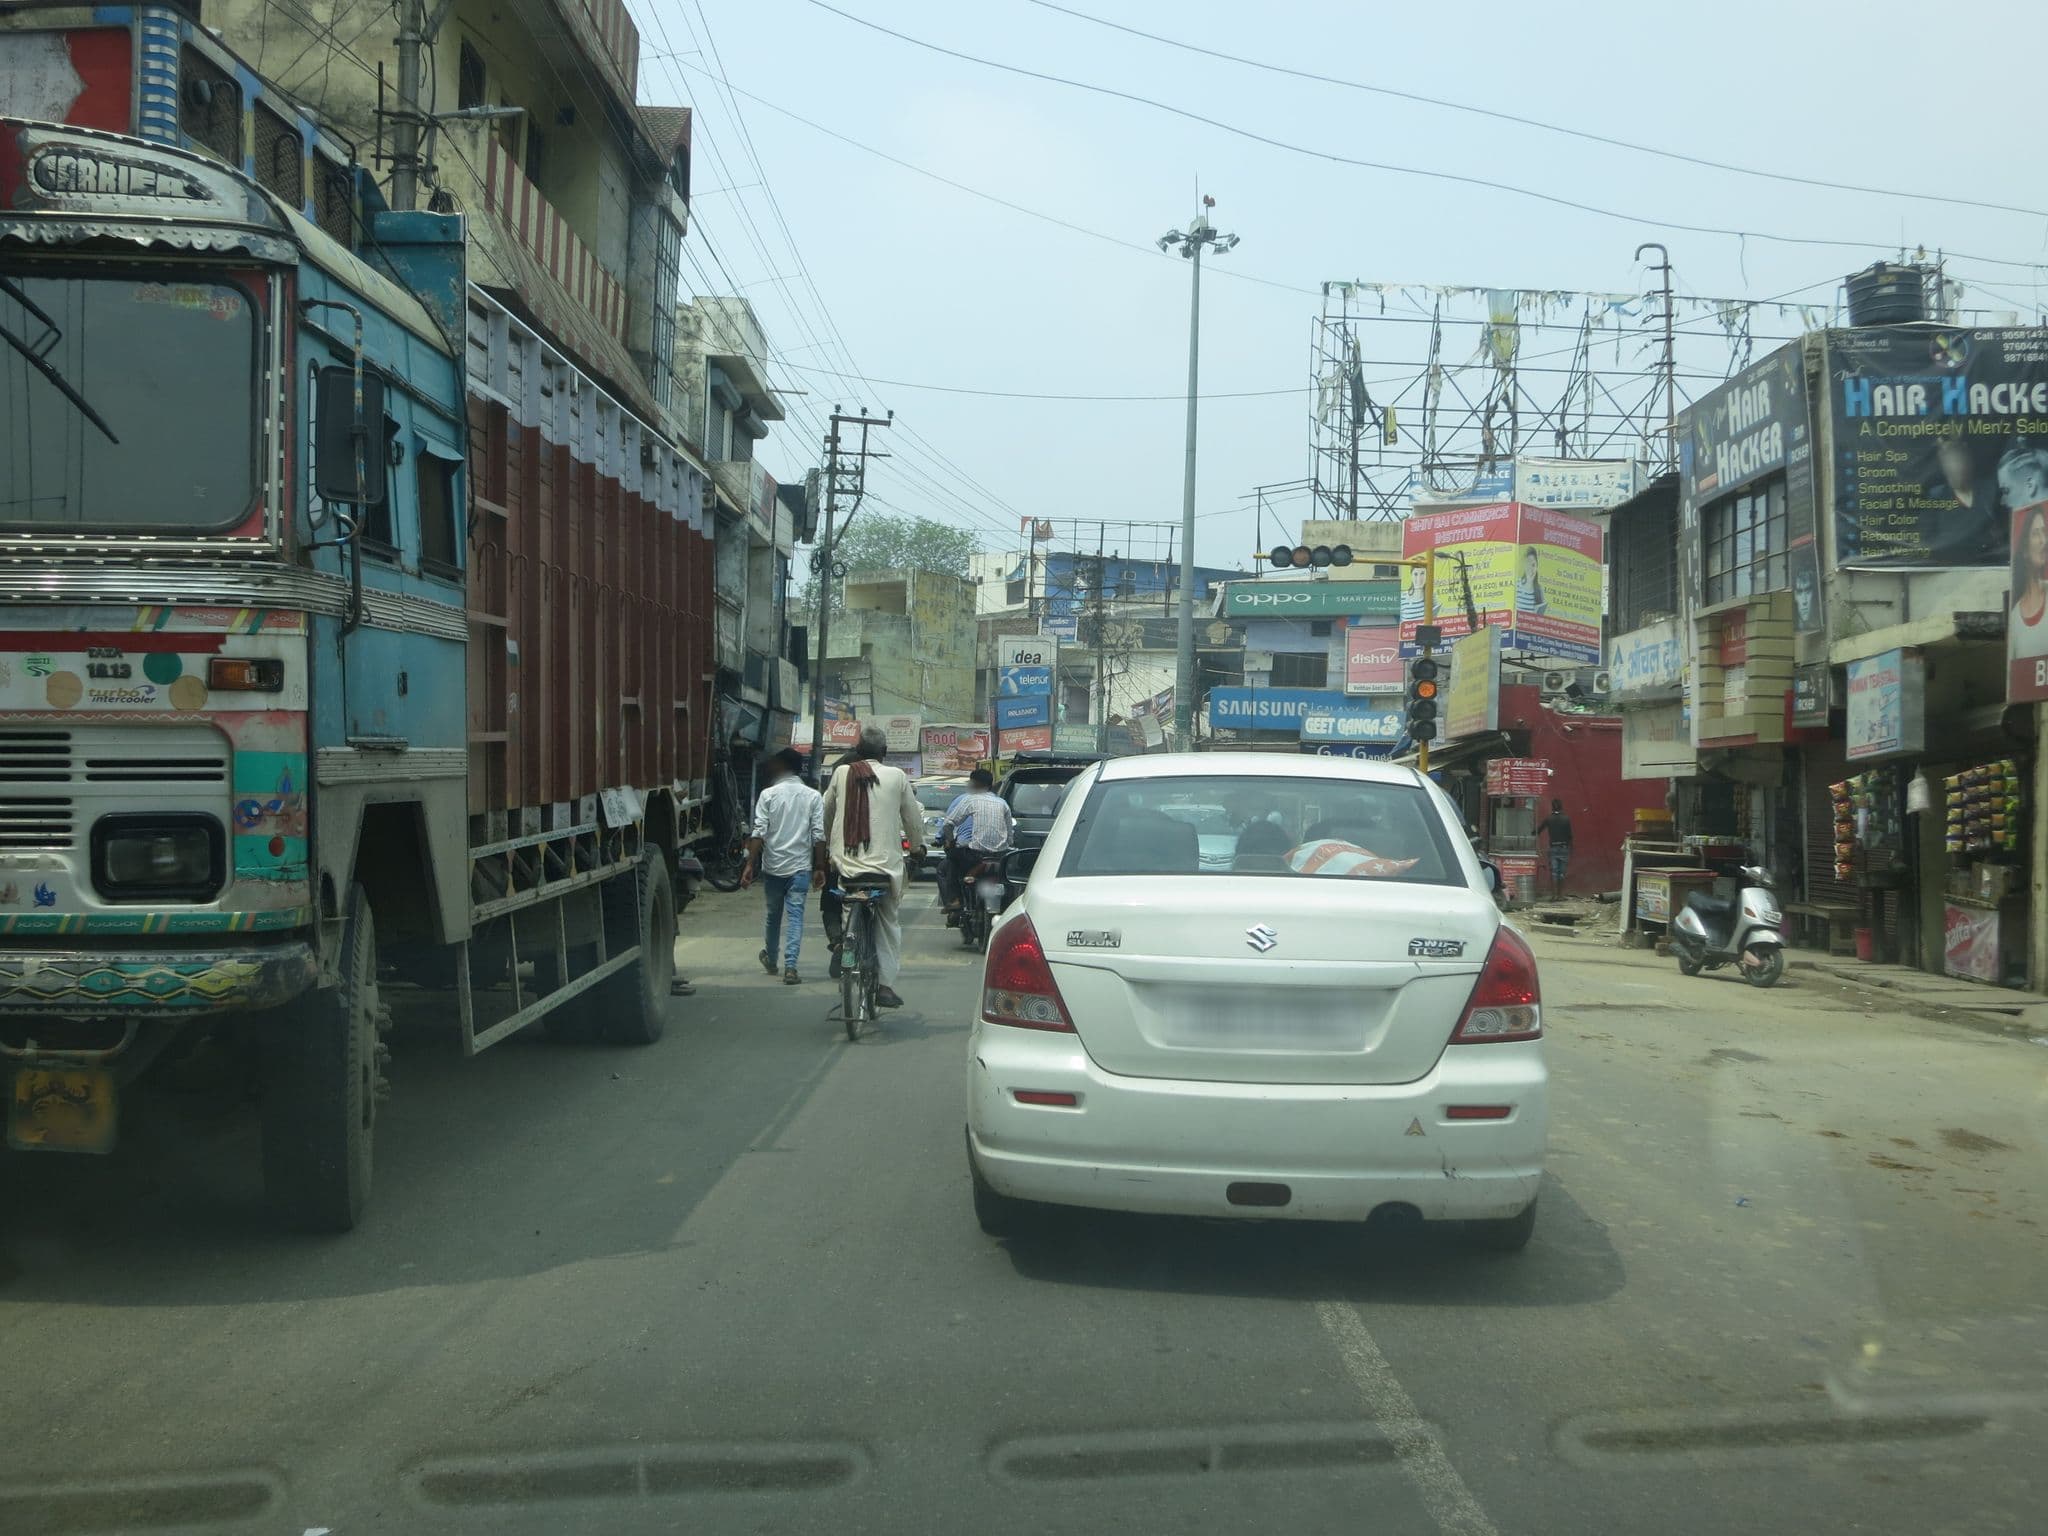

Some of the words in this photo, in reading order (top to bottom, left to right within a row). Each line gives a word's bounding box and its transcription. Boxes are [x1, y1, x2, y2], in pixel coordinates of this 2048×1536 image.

[1974, 331, 1994, 340] Call
[1844, 377, 1929, 417] HAIR
[1728, 380, 1770, 437] HAIR
[1860, 421, 1872, 437] A
[1876, 420, 1964, 439] Completely
[1716, 422, 1783, 488] HACKER
[1857, 450, 1881, 462] Hair
[1885, 450, 1908, 463] Spa
[1858, 466, 1897, 478] Groom
[1859, 482, 1921, 494] Smoothing
[1860, 499, 1892, 509] Facial
[1896, 498, 1904, 509] &
[1909, 498, 1959, 510] Massage
[1860, 515, 1885, 526] Hair
[1888, 514, 1919, 525] Color
[1434, 526, 1485, 545] INSTITUTE
[1861, 531, 1921, 542] Rebonding
[88, 687, 140, 698] turbo
[91, 694, 156, 704] intercooler
[1305, 717, 1335, 735] GEET
[1338, 716, 1380, 736] GANGA
[925, 730, 957, 746] Food
[1067, 939, 1120, 947] SUZUKI
[1410, 939, 1465, 948] SWIFT
